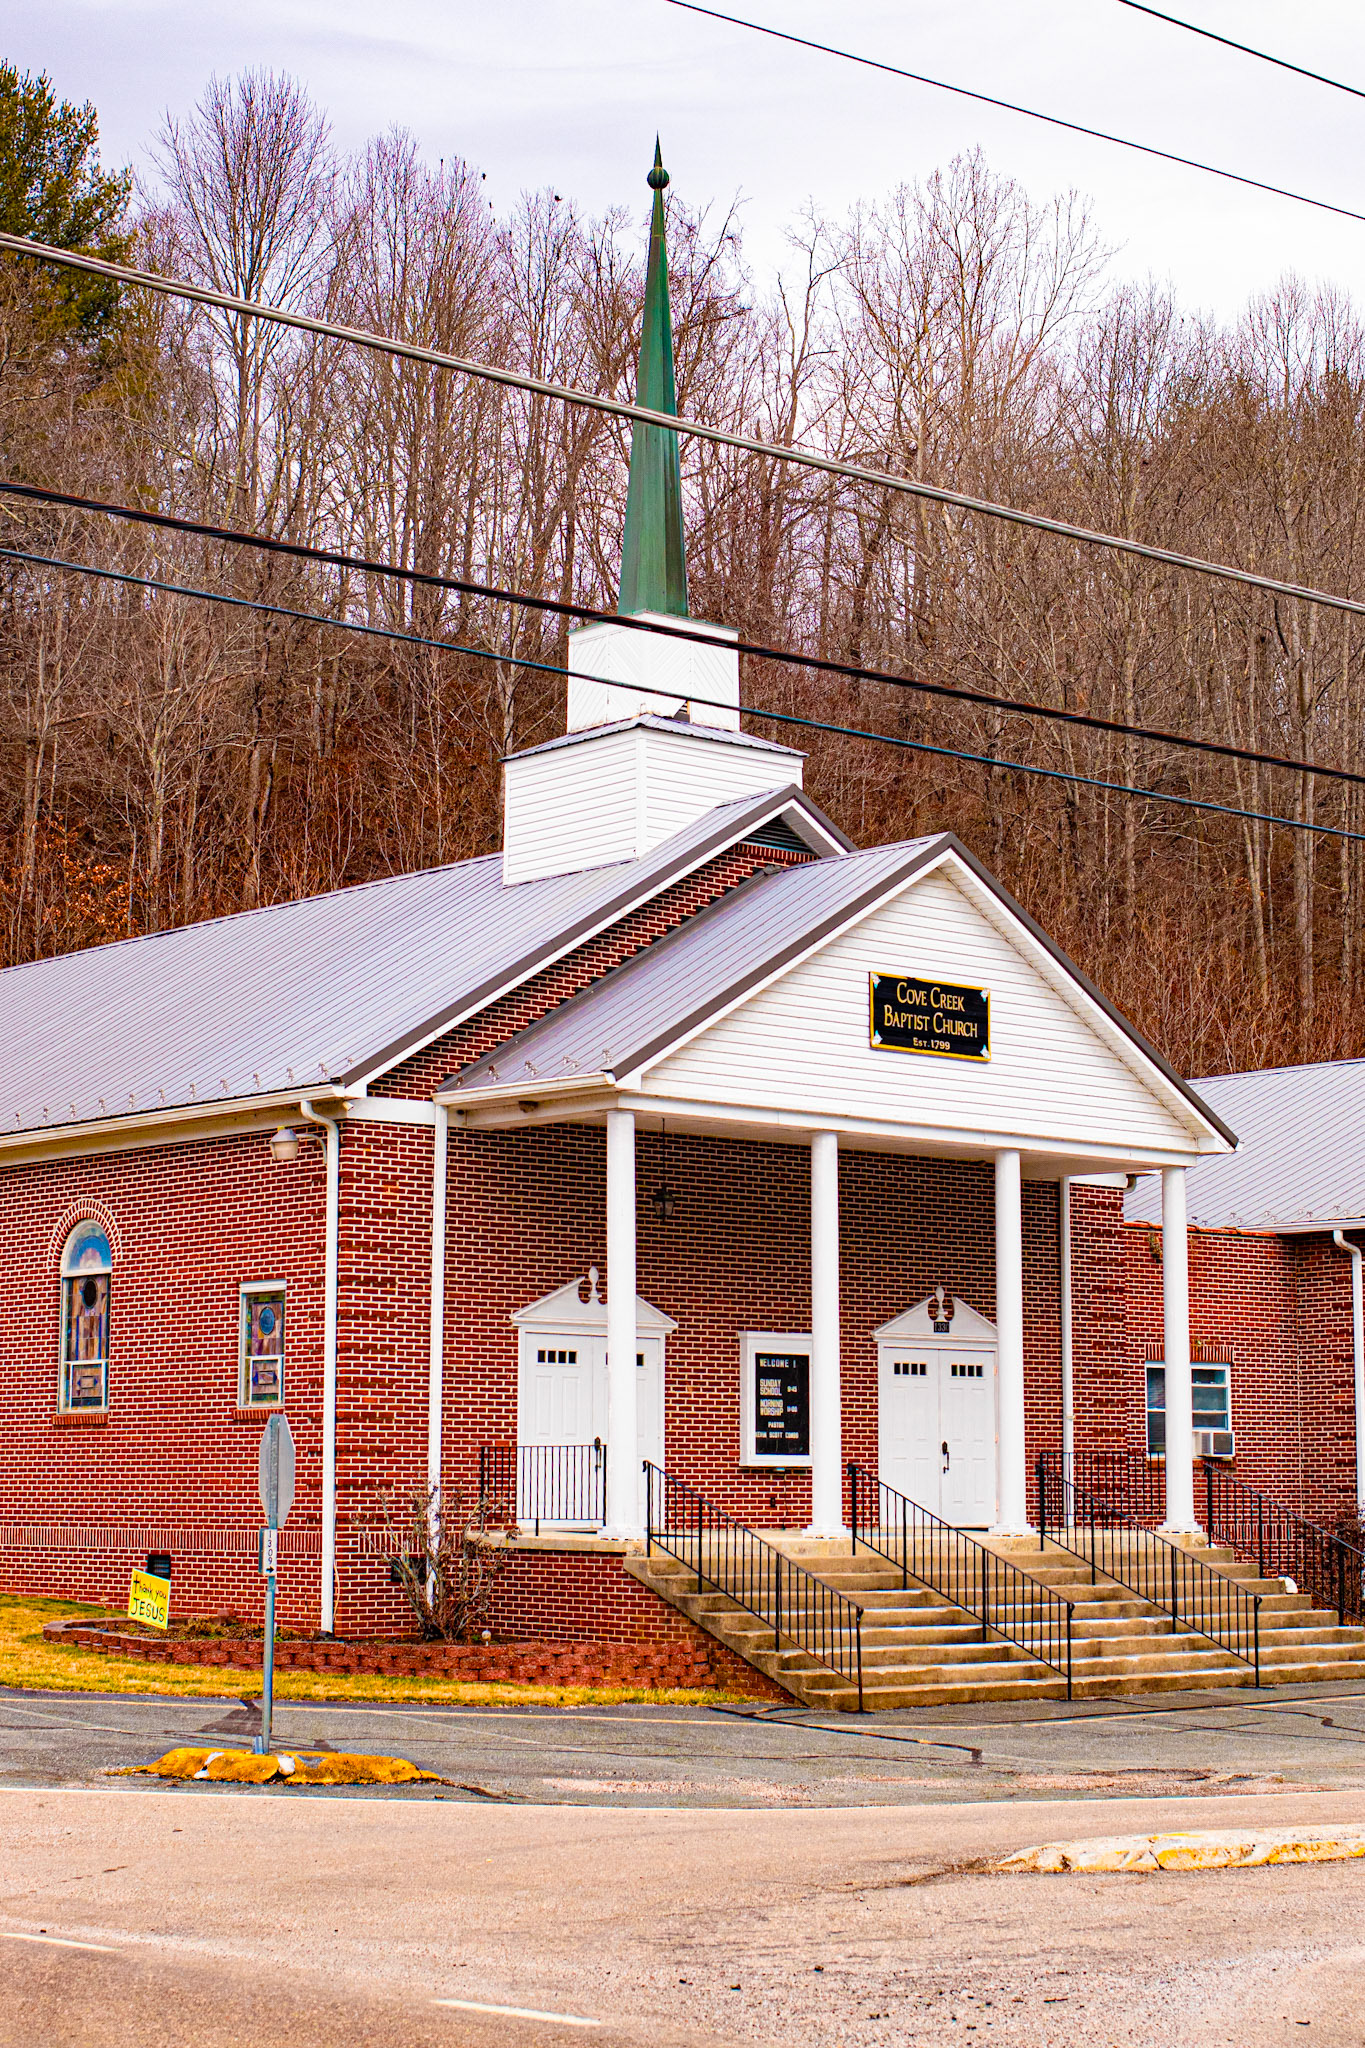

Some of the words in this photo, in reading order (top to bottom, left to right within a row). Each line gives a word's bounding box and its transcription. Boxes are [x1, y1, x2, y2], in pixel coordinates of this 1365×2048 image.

[931, 1039, 951, 1051] 1799
[759, 1358, 789, 1368] WELCOME
[759, 1378, 781, 1387] SUNDAY
[759, 1387, 782, 1396] SCHOOL
[131, 1597, 166, 1623] JESUS
